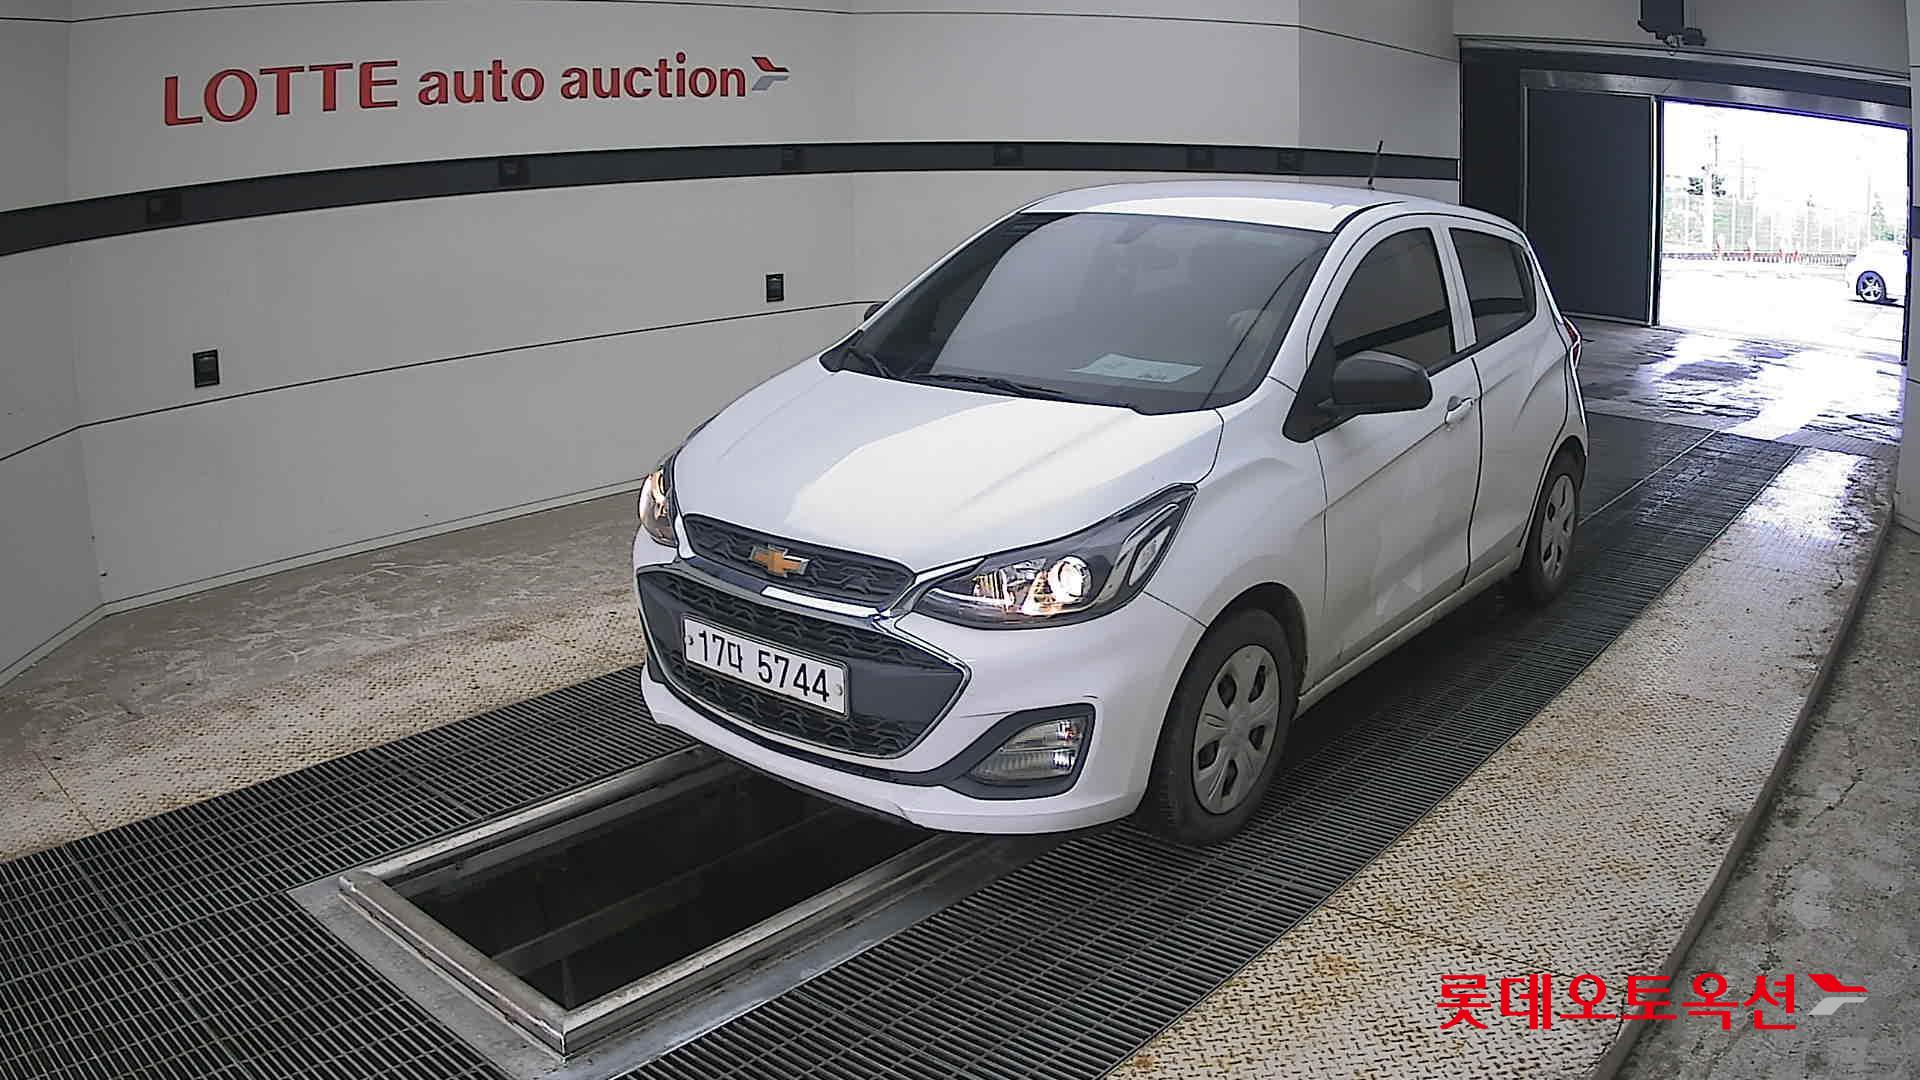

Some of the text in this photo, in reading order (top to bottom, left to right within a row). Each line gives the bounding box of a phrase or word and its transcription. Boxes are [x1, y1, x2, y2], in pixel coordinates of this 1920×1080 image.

[164, 52, 747, 126] LOTTE auto auction
[757, 649, 829, 703] 5744
